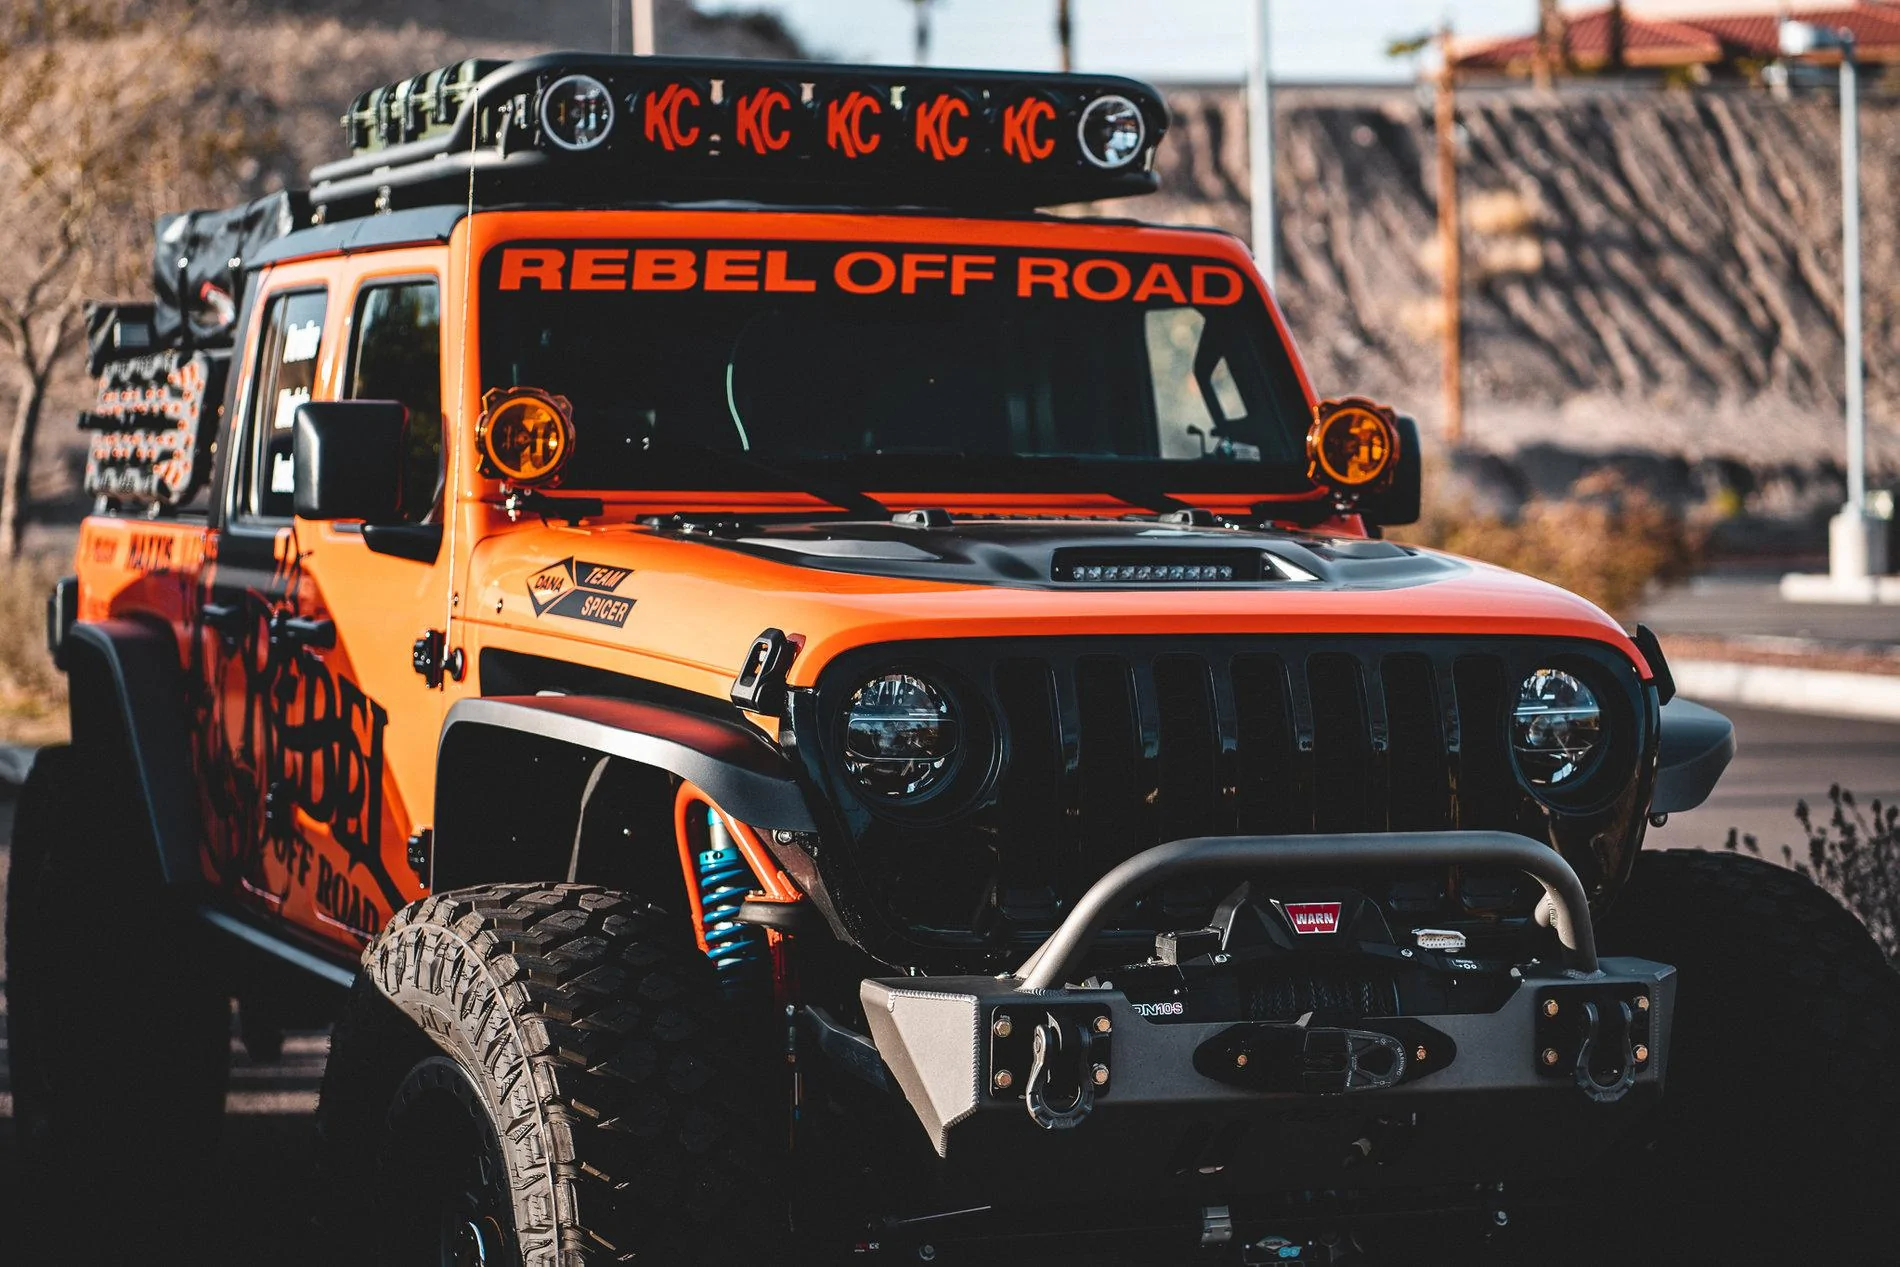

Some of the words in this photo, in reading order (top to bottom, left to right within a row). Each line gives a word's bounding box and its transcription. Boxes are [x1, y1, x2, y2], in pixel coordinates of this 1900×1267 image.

[645, 84, 700, 150] KC
[737, 88, 790, 154] KC
[828, 92, 881, 158] KC
[916, 94, 969, 160] KC
[1003, 97, 1055, 163] KC
[499, 248, 816, 292] REBEL
[834, 252, 996, 296] OFF
[1017, 257, 1243, 305] ROAD
[535, 574, 564, 592] DANA
[581, 596, 629, 622] SPICER
[584, 567, 626, 588] TEAM
[315, 854, 380, 937] ROAD
[1296, 912, 1335, 925] WARN
